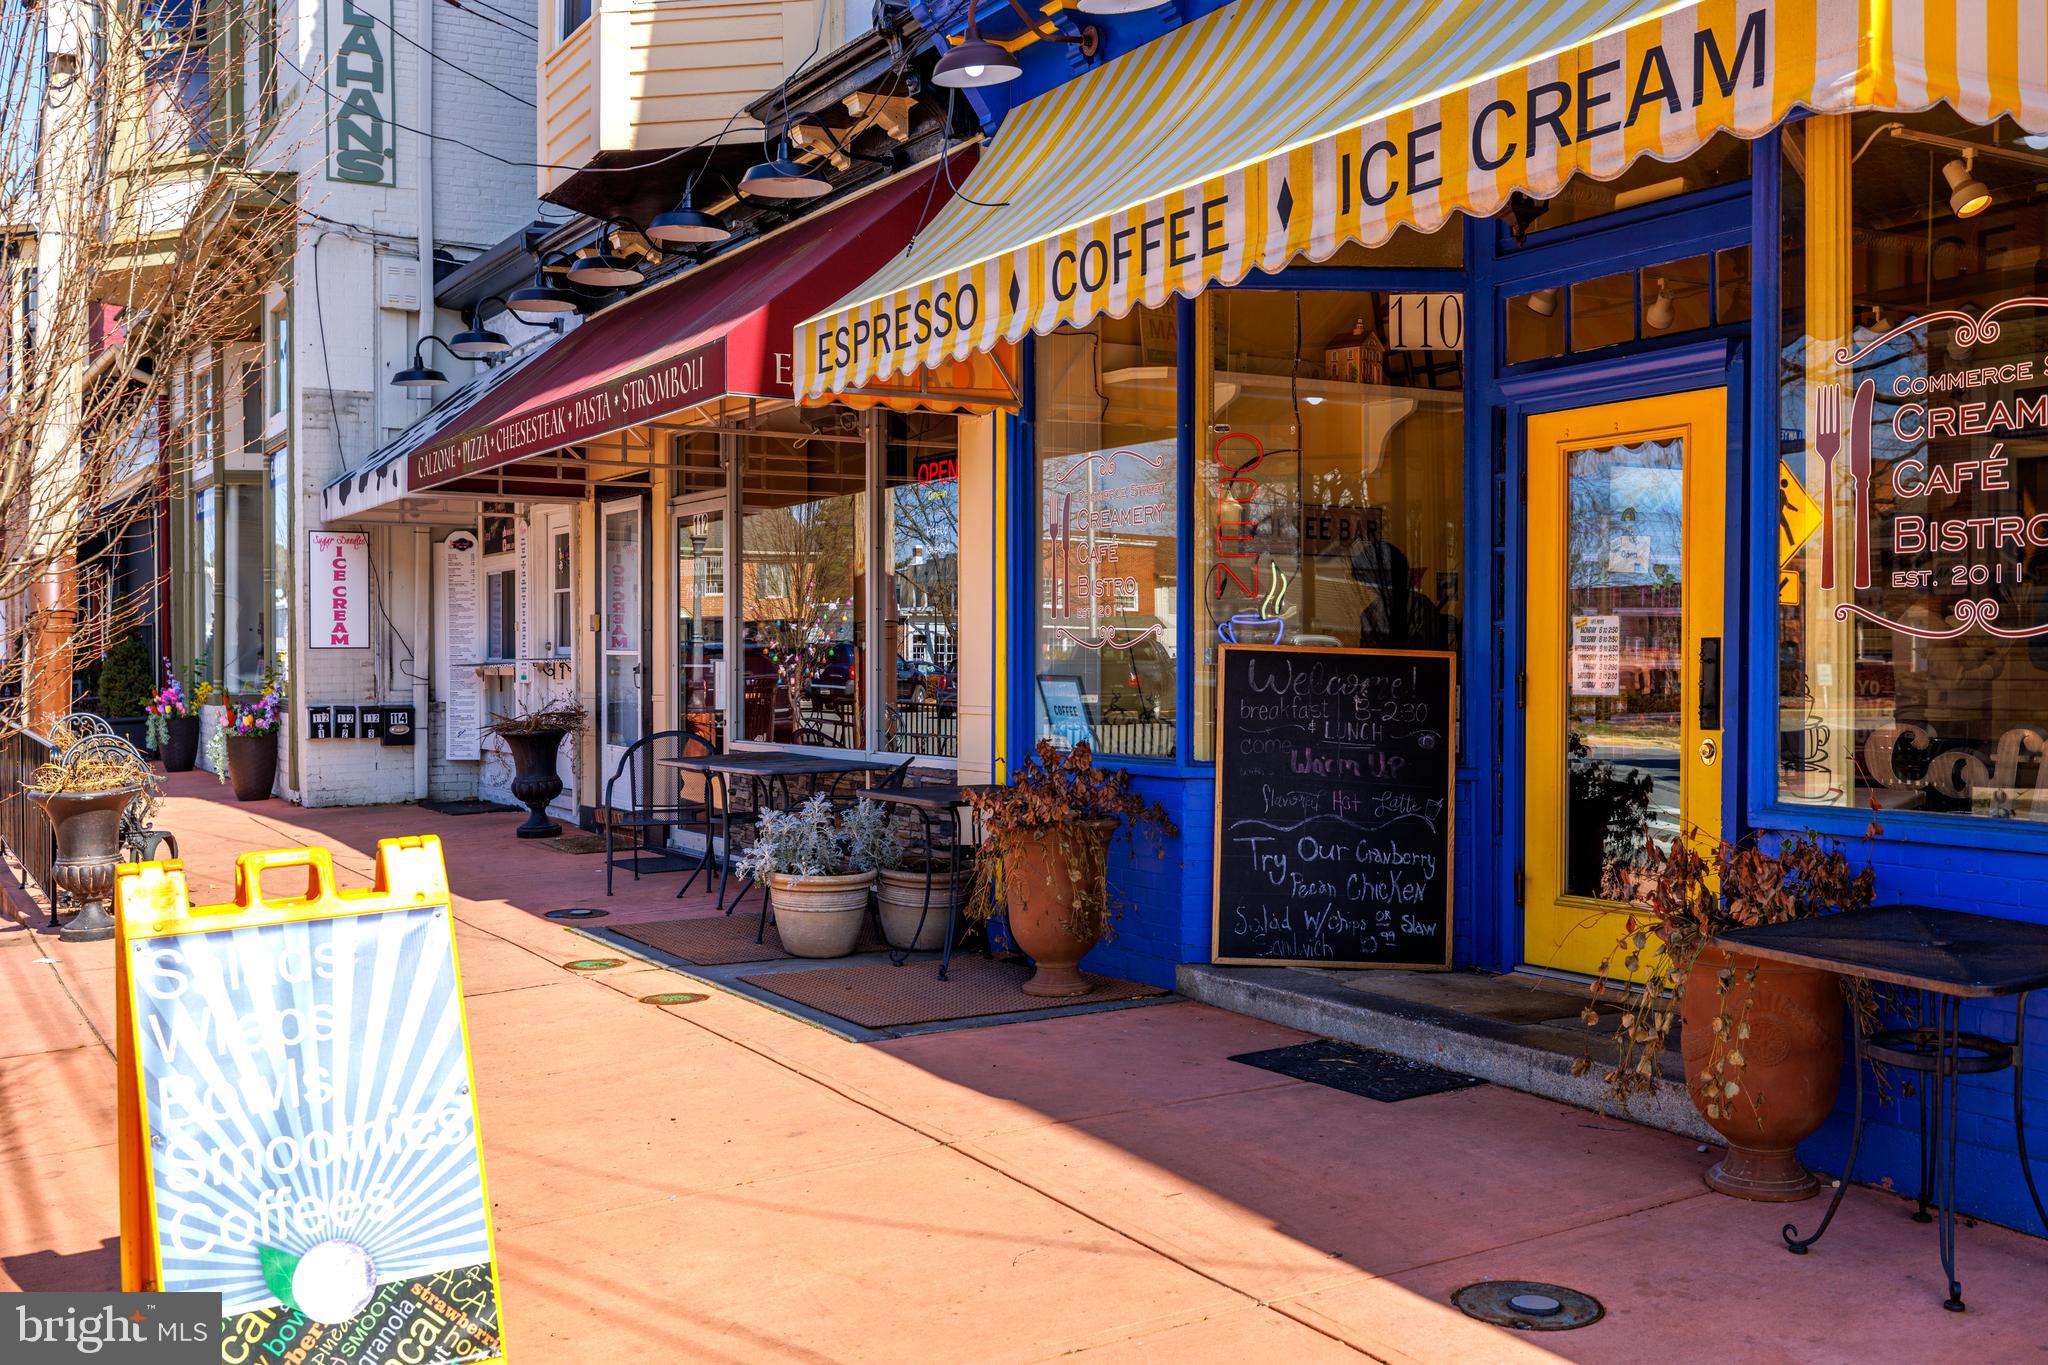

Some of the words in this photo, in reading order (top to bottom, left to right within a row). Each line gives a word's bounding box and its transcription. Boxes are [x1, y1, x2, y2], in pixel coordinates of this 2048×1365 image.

[1340, 121, 1443, 215] ICE
[1471, 8, 1767, 171] CREAM
[1051, 194, 1230, 302] COFFEE
[817, 283, 979, 374] ESPRESSO
[1390, 294, 1462, 349] 110
[1893, 361, 2034, 397] COMMERCE
[418, 446, 457, 479] CALZONE
[463, 433, 490, 464] PIZZA
[495, 406, 566, 453] CHEESESTEAK
[575, 391, 612, 429] PASTA
[621, 356, 704, 413] STROMBOLI
[917, 458, 959, 487] OPEN
[1892, 443, 2011, 498] CAFÉ
[1129, 482, 1166, 498] STREET
[693, 512, 708, 536] 112
[1076, 502, 1166, 531] CREAMERY
[1214, 432, 1264, 600] OPEN
[313, 535, 335, 552] Sugar
[337, 535, 366, 550] Doodles
[332, 546, 347, 582] ICE
[1892, 569, 1939, 588] EST.
[1951, 562, 2023, 586] 2011
[1077, 575, 1137, 598] BISTRO
[330, 586, 349, 645] CREAM
[313, 714, 330, 723] 112
[337, 714, 354, 723] 112
[363, 714, 380, 723] 112
[390, 712, 408, 724] 114
[1053, 704, 1079, 717] COFFEE
[1239, 696, 1329, 721] breakfast
[1239, 736, 1292, 754] come
[1324, 721, 1382, 742] LUNCH
[1233, 836, 1287, 885] Try
[1297, 836, 1350, 862] Our
[1290, 871, 1337, 899] Pecan
[1234, 904, 1293, 935] Salad
